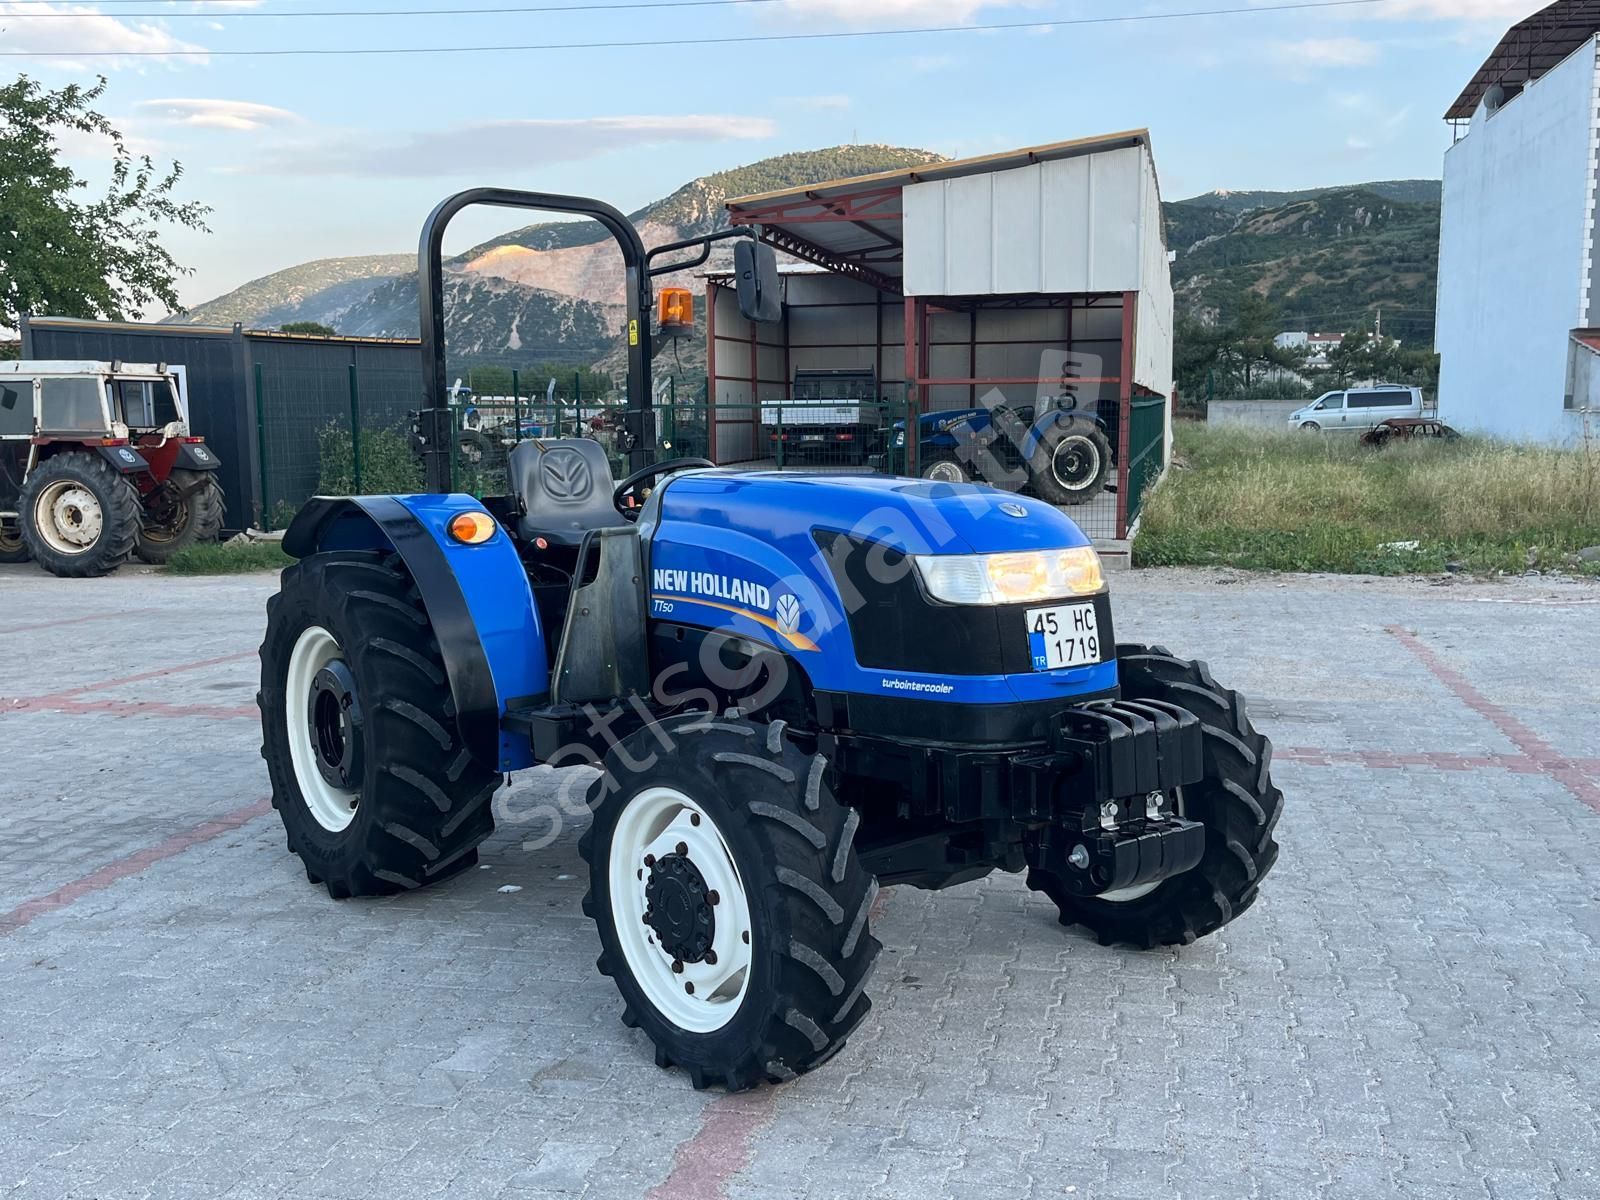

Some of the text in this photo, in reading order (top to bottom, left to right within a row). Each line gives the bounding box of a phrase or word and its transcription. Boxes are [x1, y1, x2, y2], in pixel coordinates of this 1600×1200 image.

[654, 569, 770, 611] NEW HOLLAND
[1033, 608, 1094, 637] 45 HC
[1034, 656, 1046, 667] TR
[1055, 635, 1098, 663] 1719
[882, 677, 954, 694] turbointercooler
